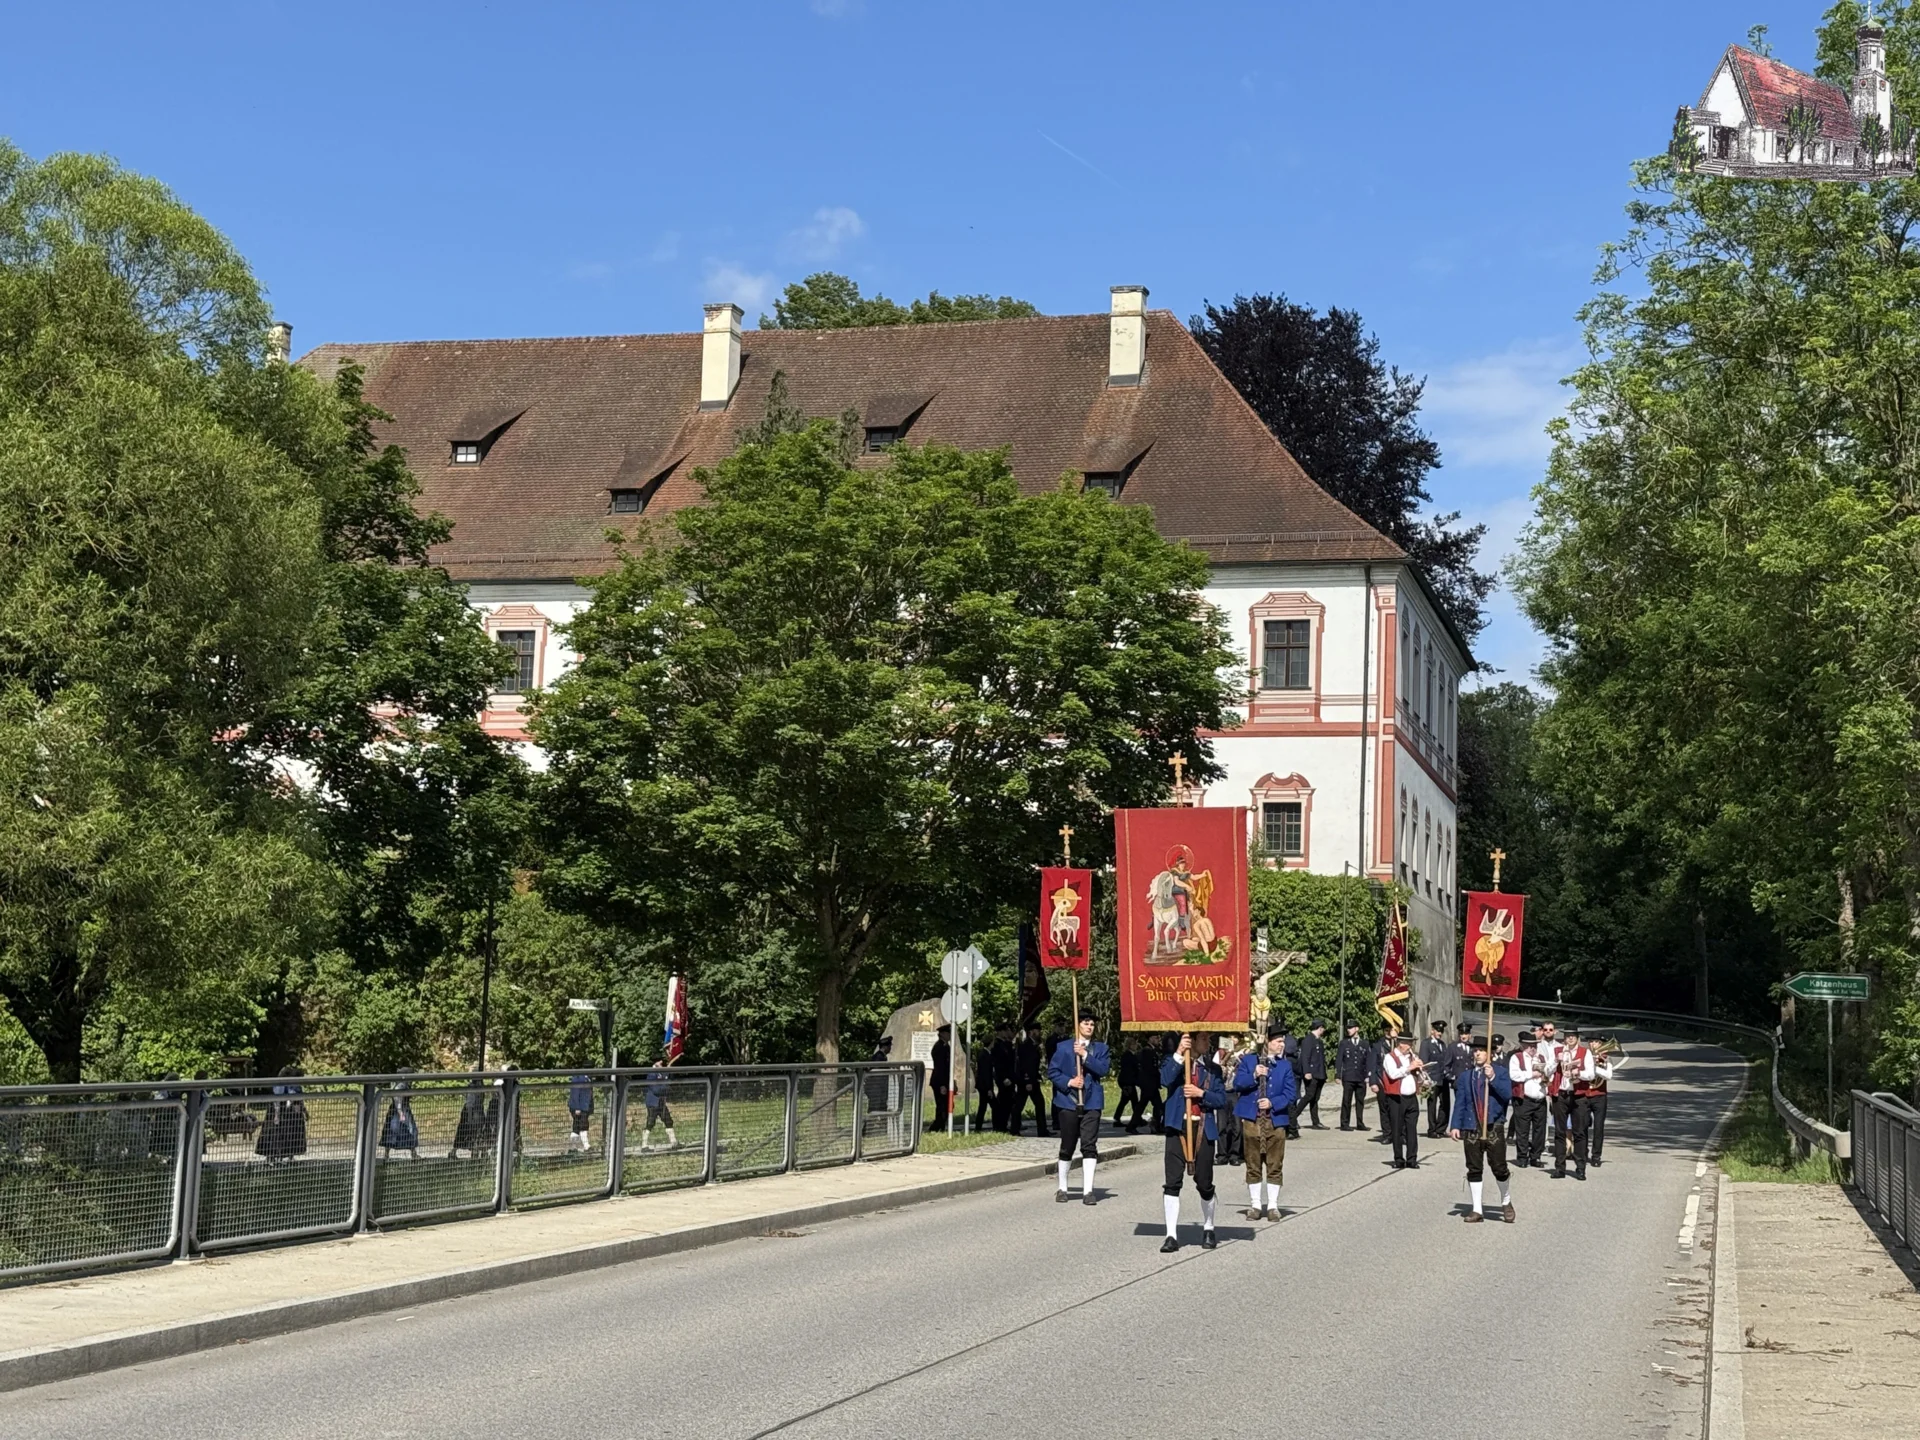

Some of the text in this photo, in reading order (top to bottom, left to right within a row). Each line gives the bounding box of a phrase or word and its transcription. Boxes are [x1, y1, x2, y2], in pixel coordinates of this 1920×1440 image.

[1137, 974, 1235, 989] SANKT MARTIN
[1809, 979, 1858, 988] Katzenhaus
[1146, 990, 1173, 1001] BITTE
[1201, 990, 1226, 1000] UNS
